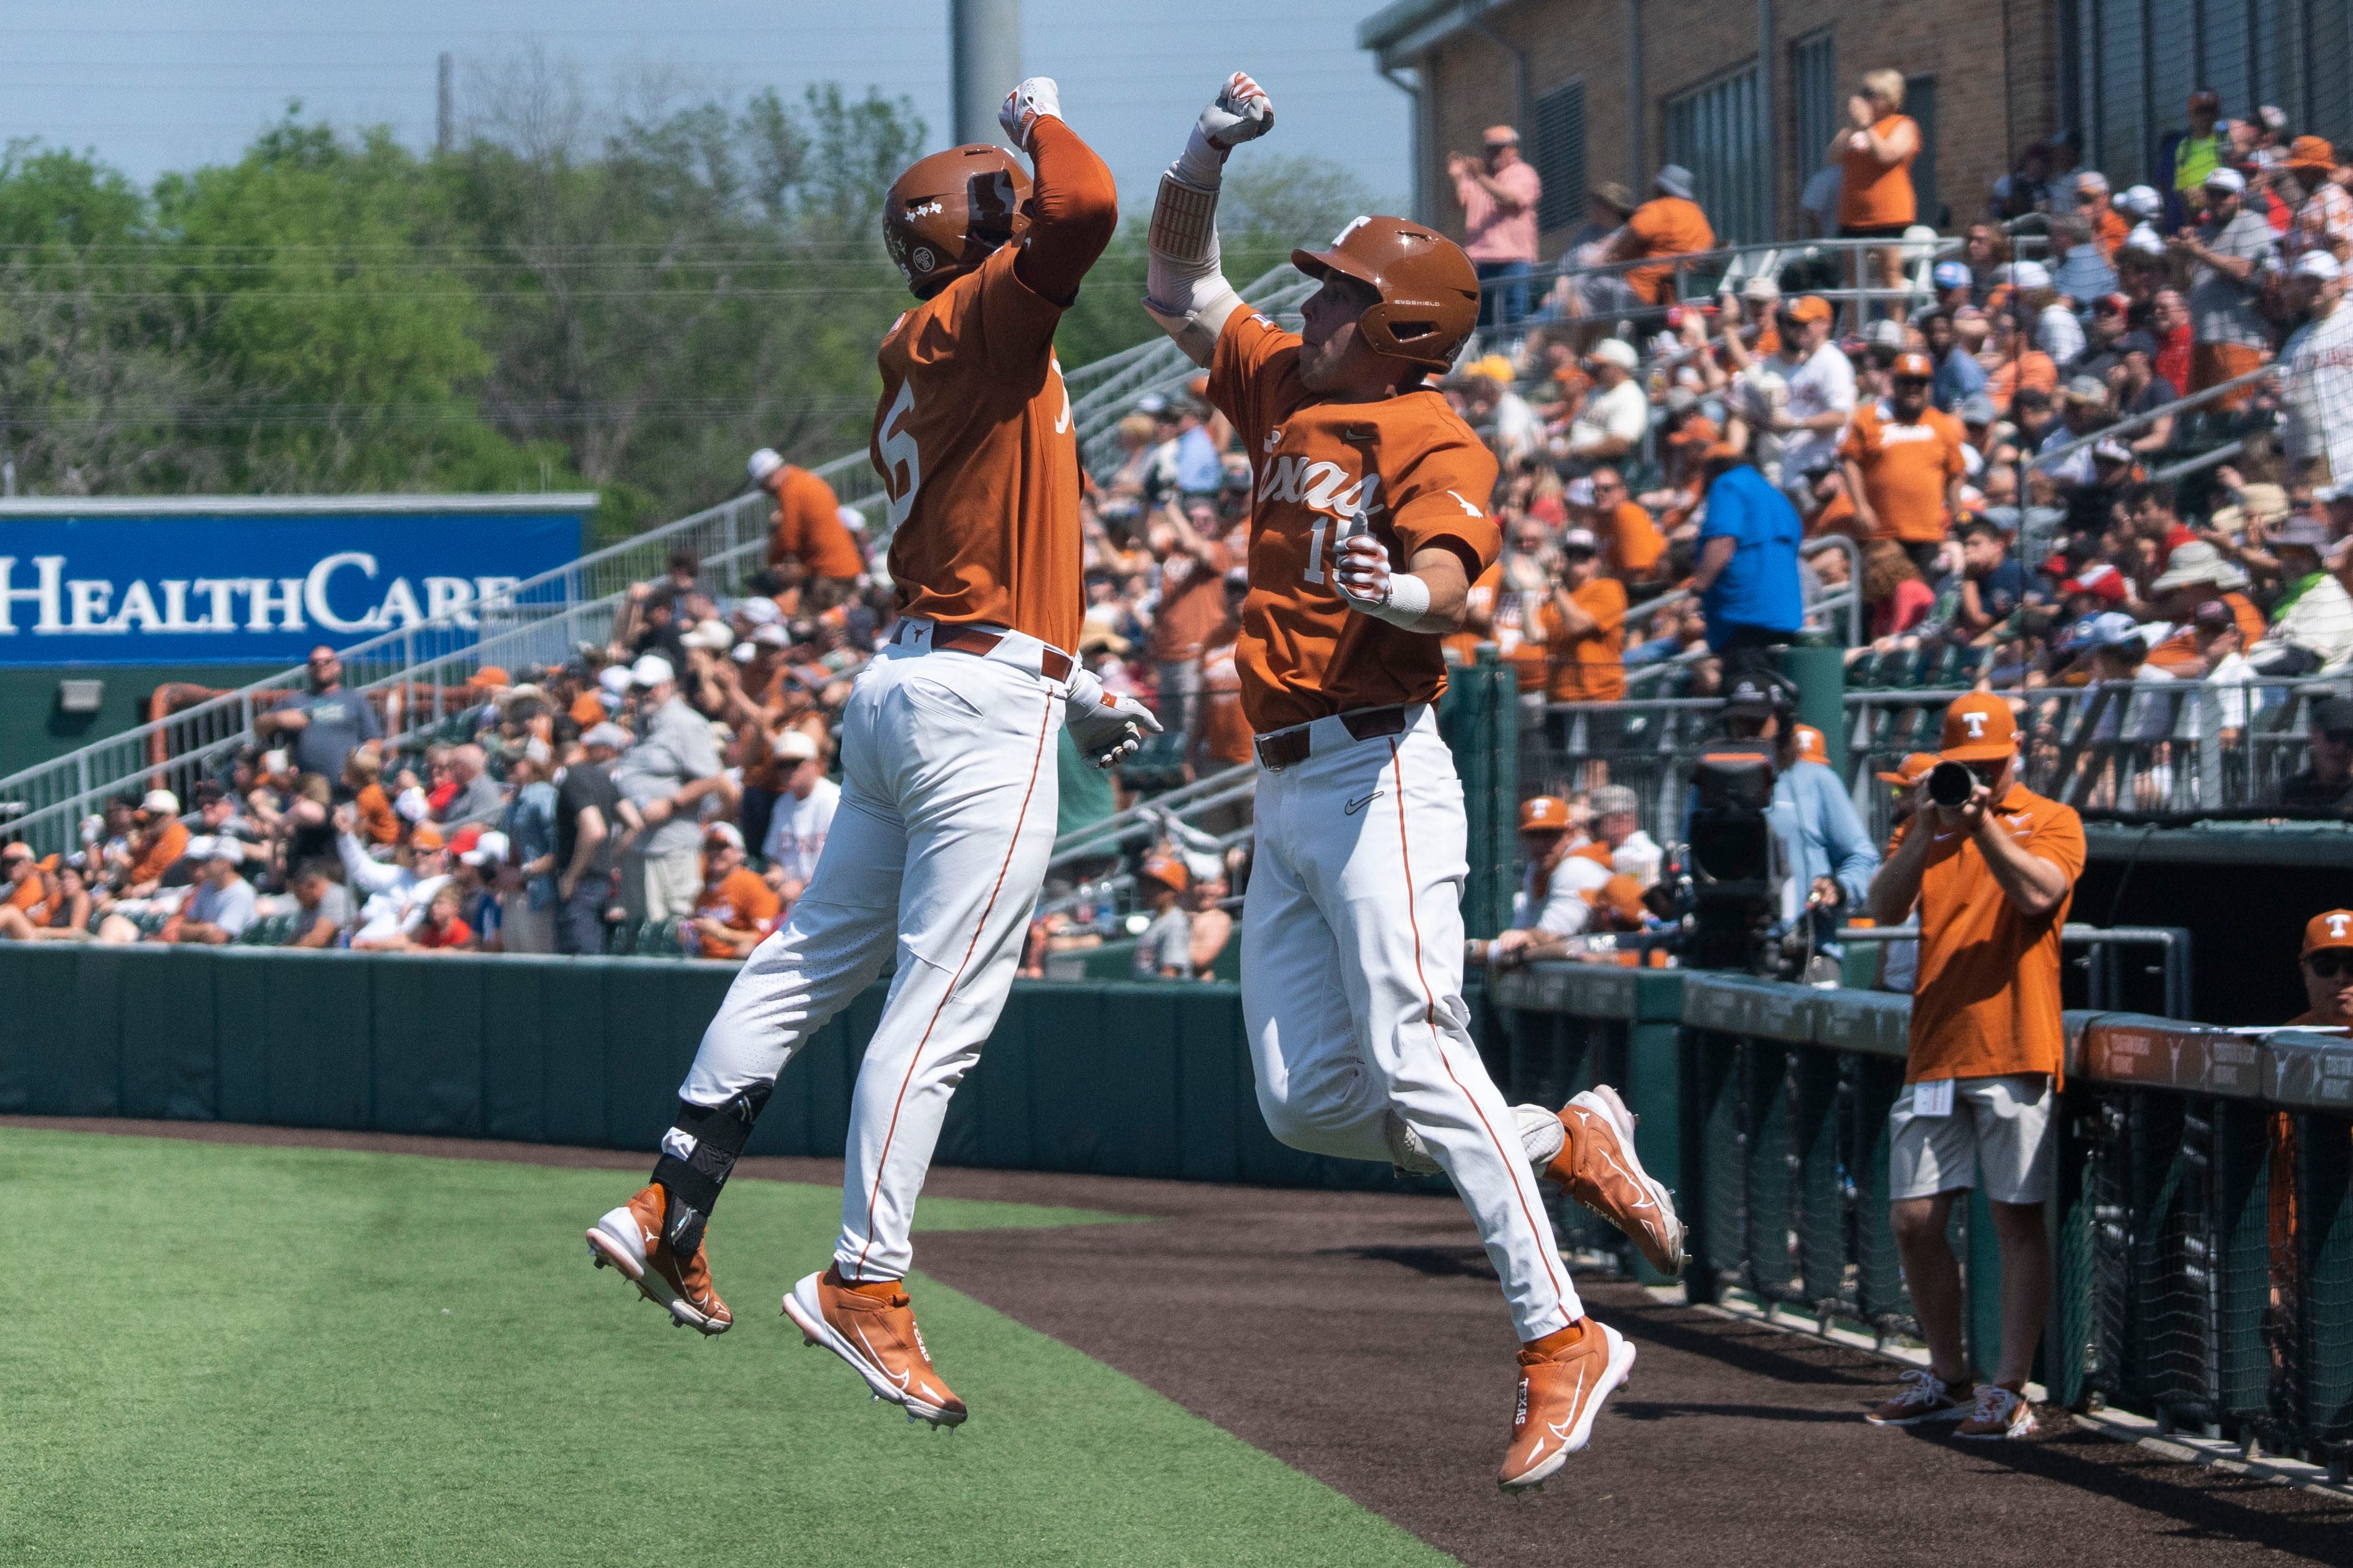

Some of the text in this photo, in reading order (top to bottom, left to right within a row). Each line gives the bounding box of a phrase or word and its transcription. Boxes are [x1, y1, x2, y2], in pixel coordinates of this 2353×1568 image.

[915, 250, 929, 263] GUS
[922, 260, 931, 270] 18
[1962, 711, 1989, 739] T
[2325, 913, 2351, 938] T
[1584, 1200, 1622, 1230] TEXAS
[1515, 1377, 1529, 1426] TEXAS
